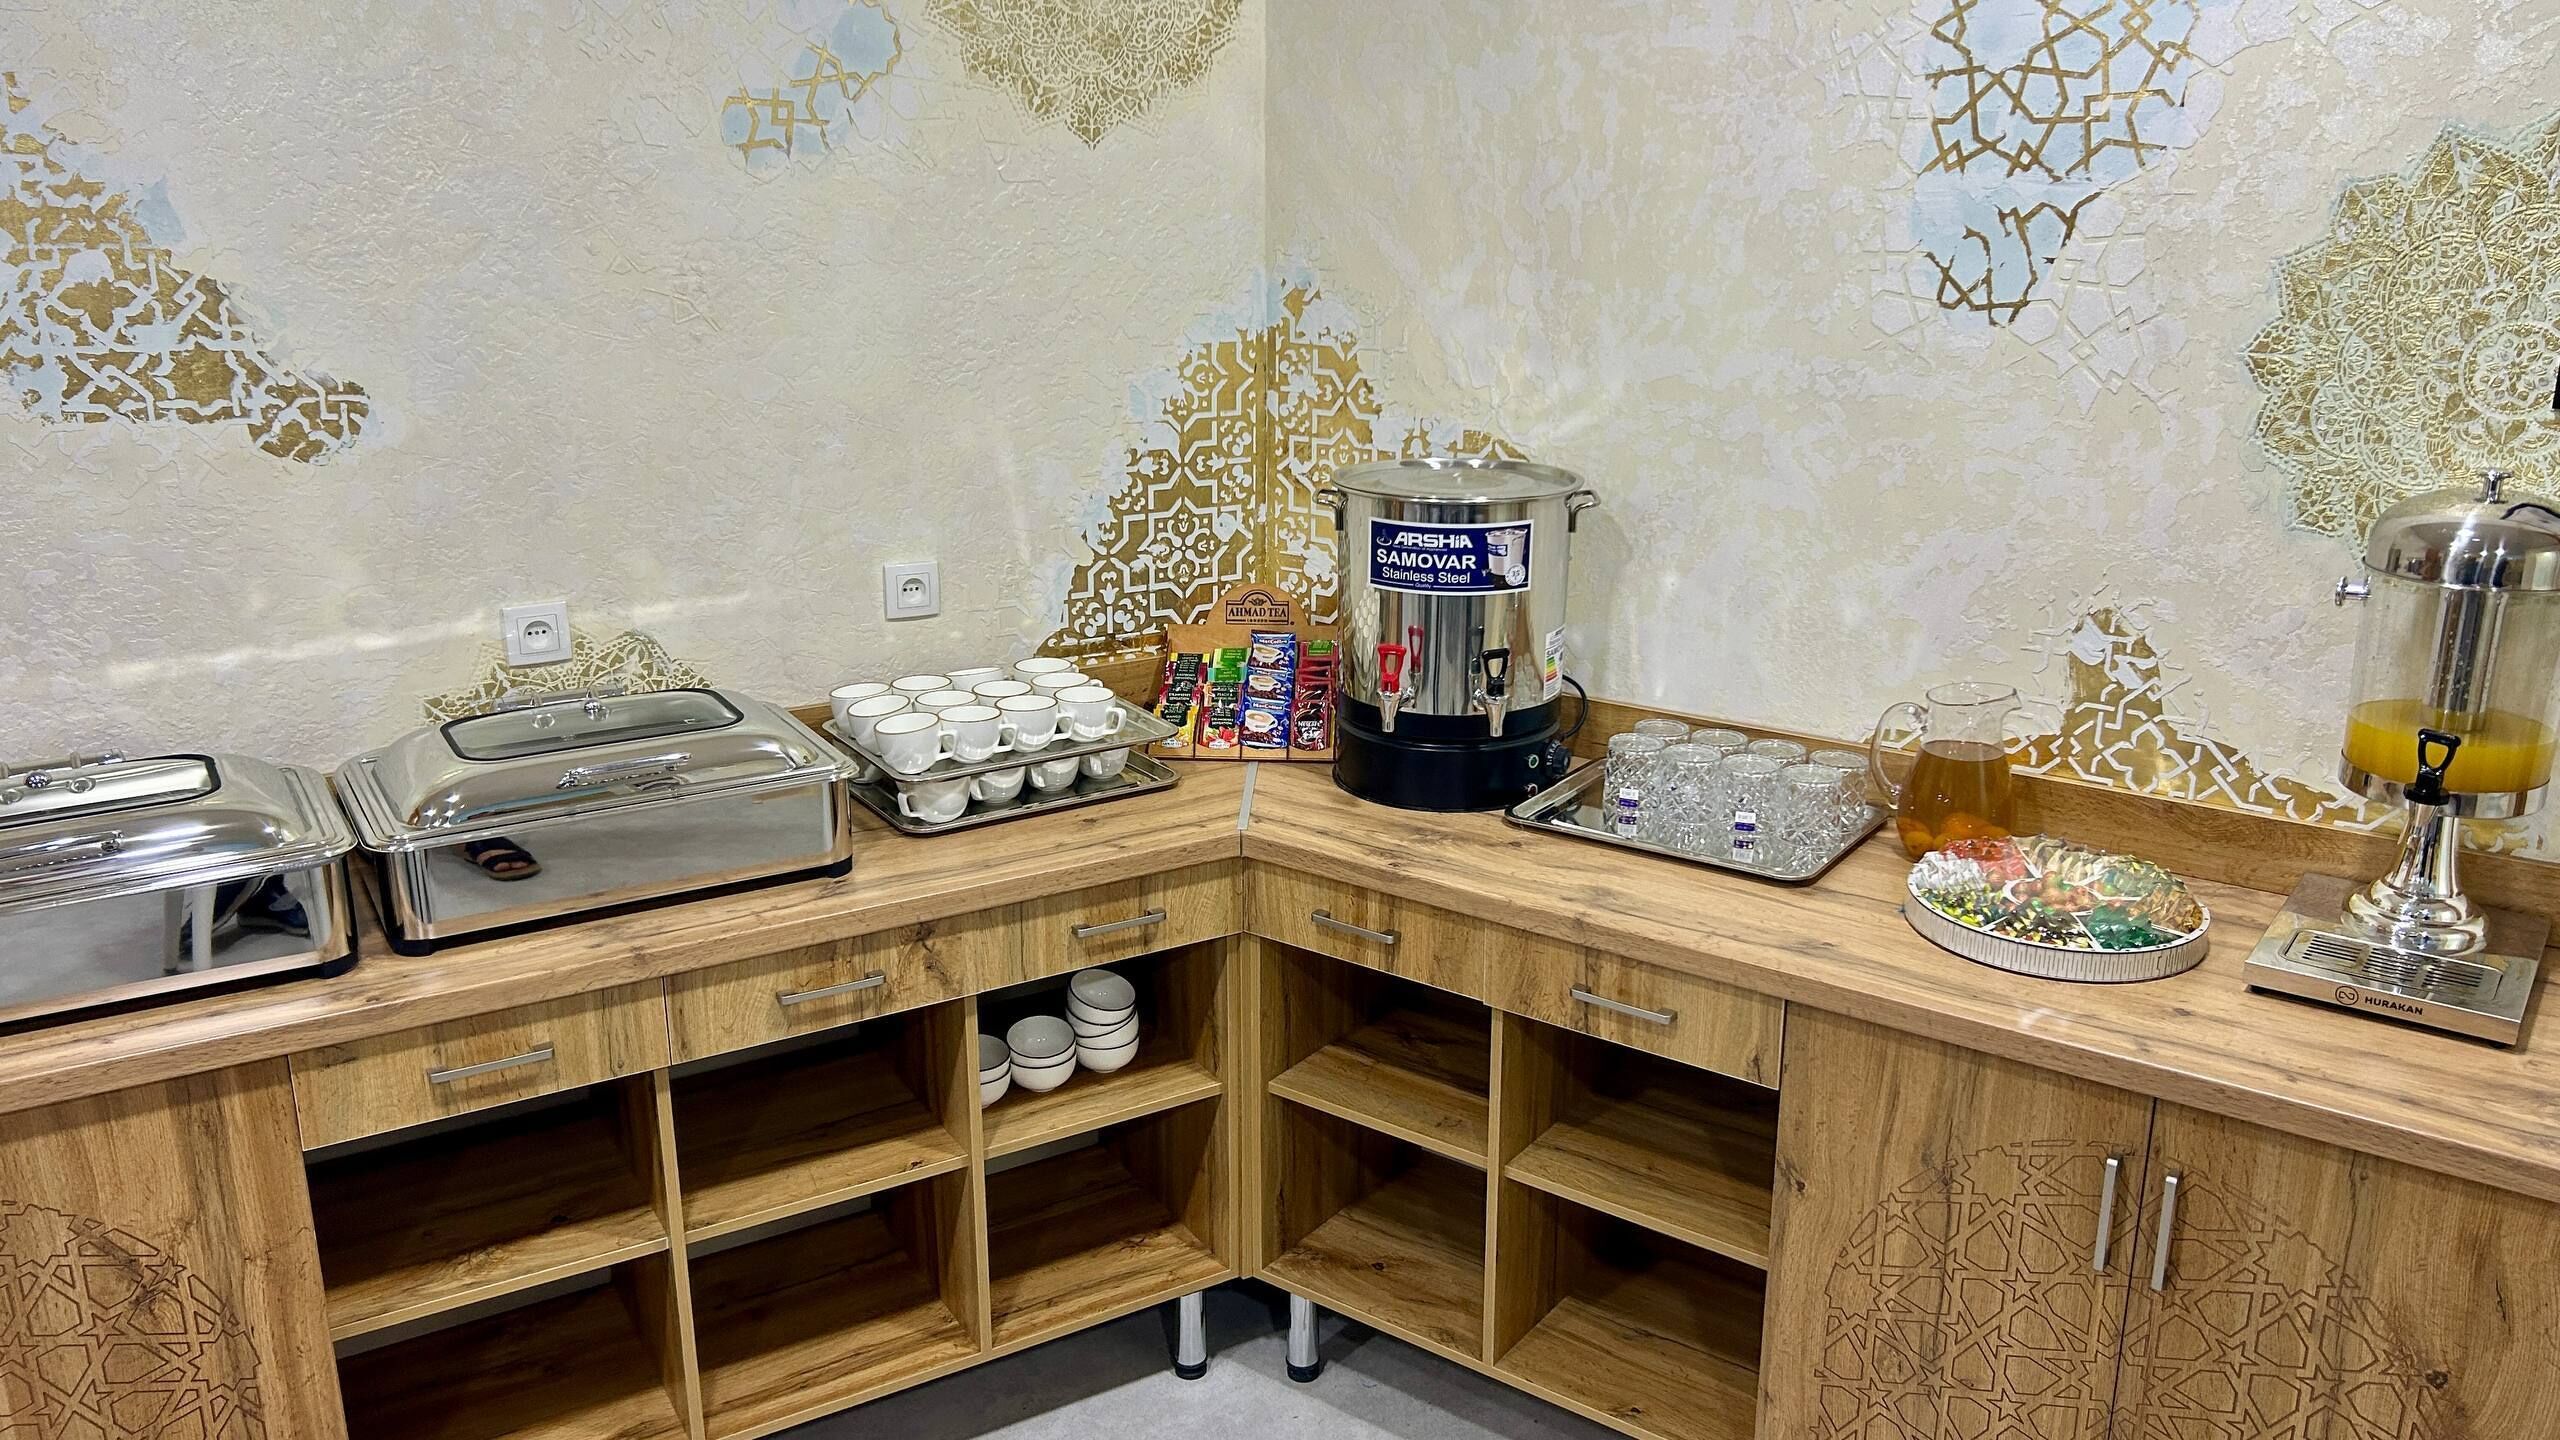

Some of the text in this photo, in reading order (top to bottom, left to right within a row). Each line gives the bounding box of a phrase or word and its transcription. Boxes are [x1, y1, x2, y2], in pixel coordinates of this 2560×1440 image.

[1376, 548, 1477, 570] SAMOVAR
[1382, 566, 1470, 584] Stainless Steel
[1228, 607, 1287, 617] AHMAD TEA
[2365, 996, 2423, 1015] HURAKAN
